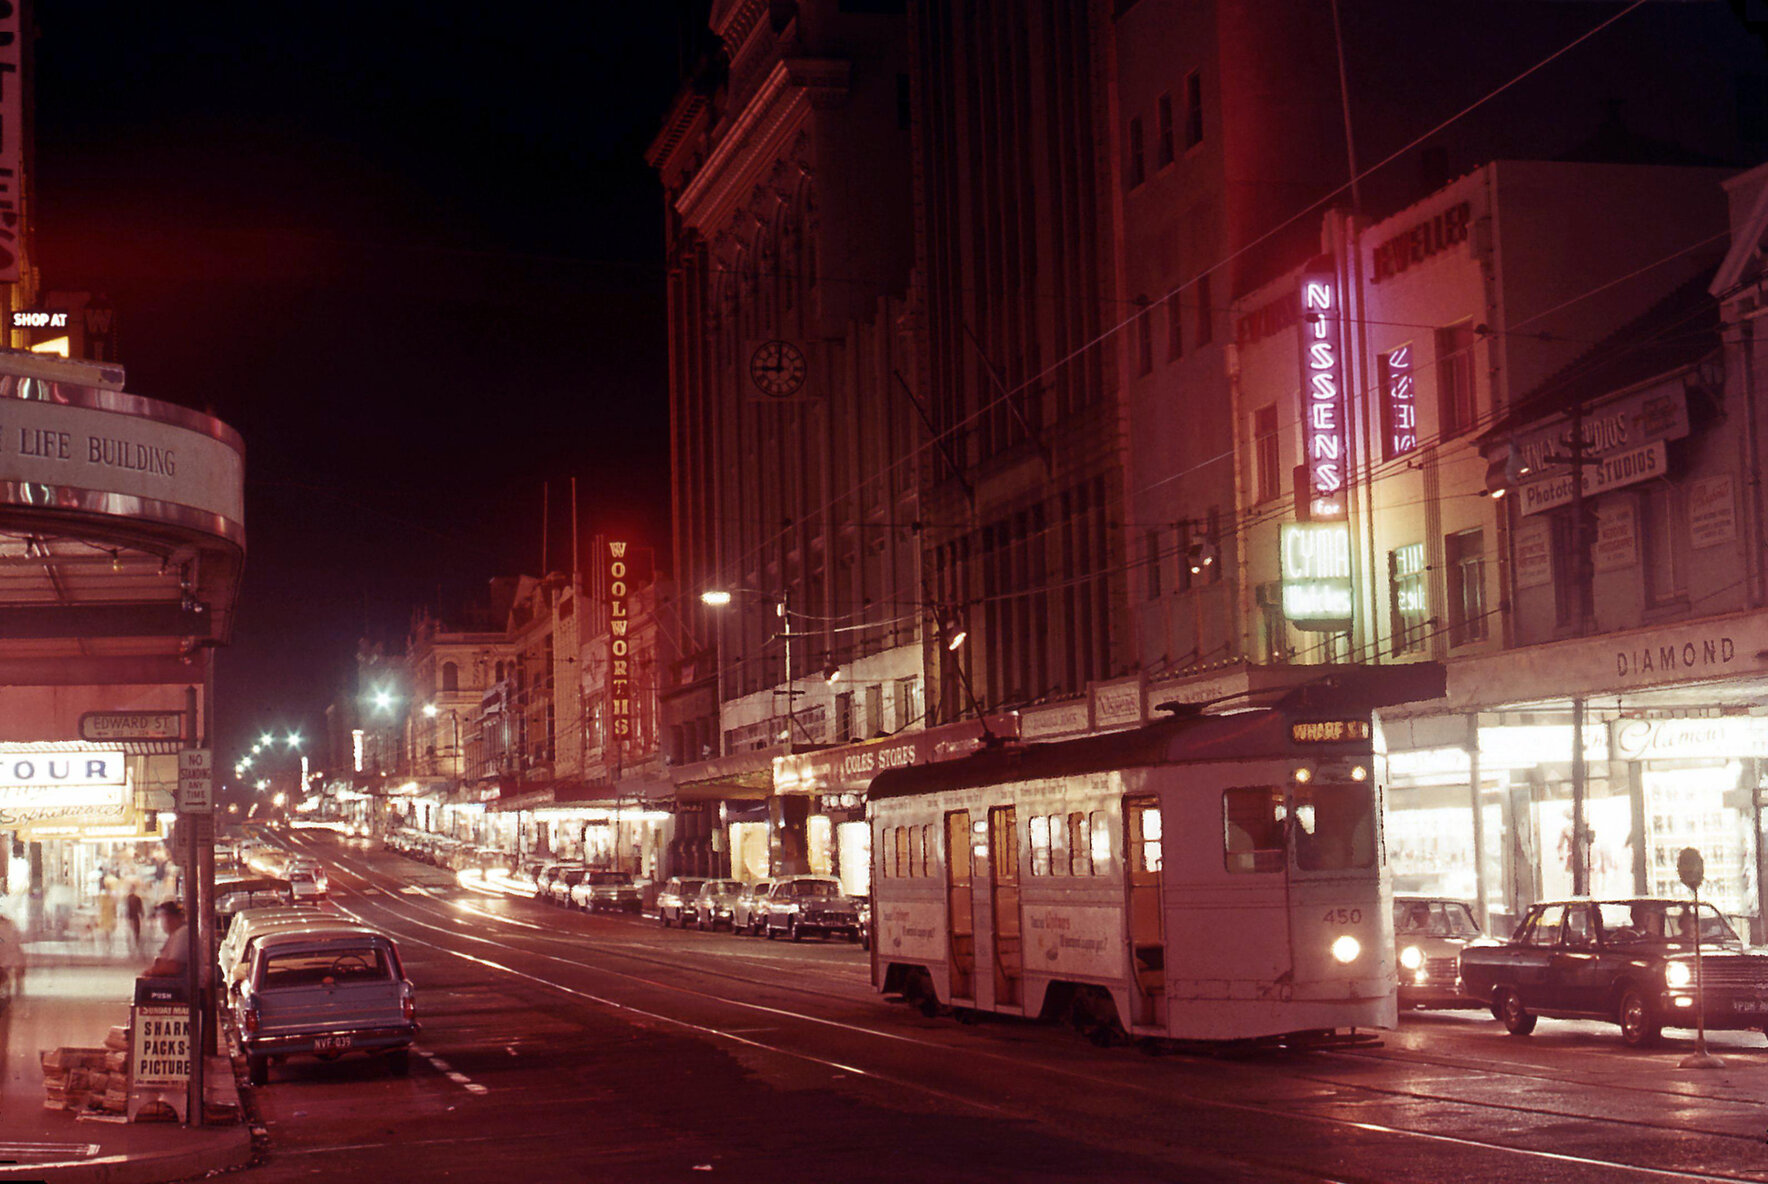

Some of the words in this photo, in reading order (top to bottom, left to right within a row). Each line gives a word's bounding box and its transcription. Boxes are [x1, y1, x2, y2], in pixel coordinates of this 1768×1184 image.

[13, 313, 50, 326] SHOP
[50, 313, 67, 326] AT
[1306, 283, 1340, 491] NISSENS
[19, 427, 72, 461] LIFE
[88, 436, 175, 477] BUILDING
[1597, 447, 1656, 486] STUDIOS
[609, 541, 630, 736] WOOLWORTHS
[1617, 638, 1735, 677] DIAMOND
[94, 716, 148, 730] EDWARD
[188, 754, 203, 766] NO
[878, 745, 916, 768] STORES
[186, 790, 206, 799] TIME
[1323, 908, 1362, 925] 450
[151, 992, 172, 1000] PUSH
